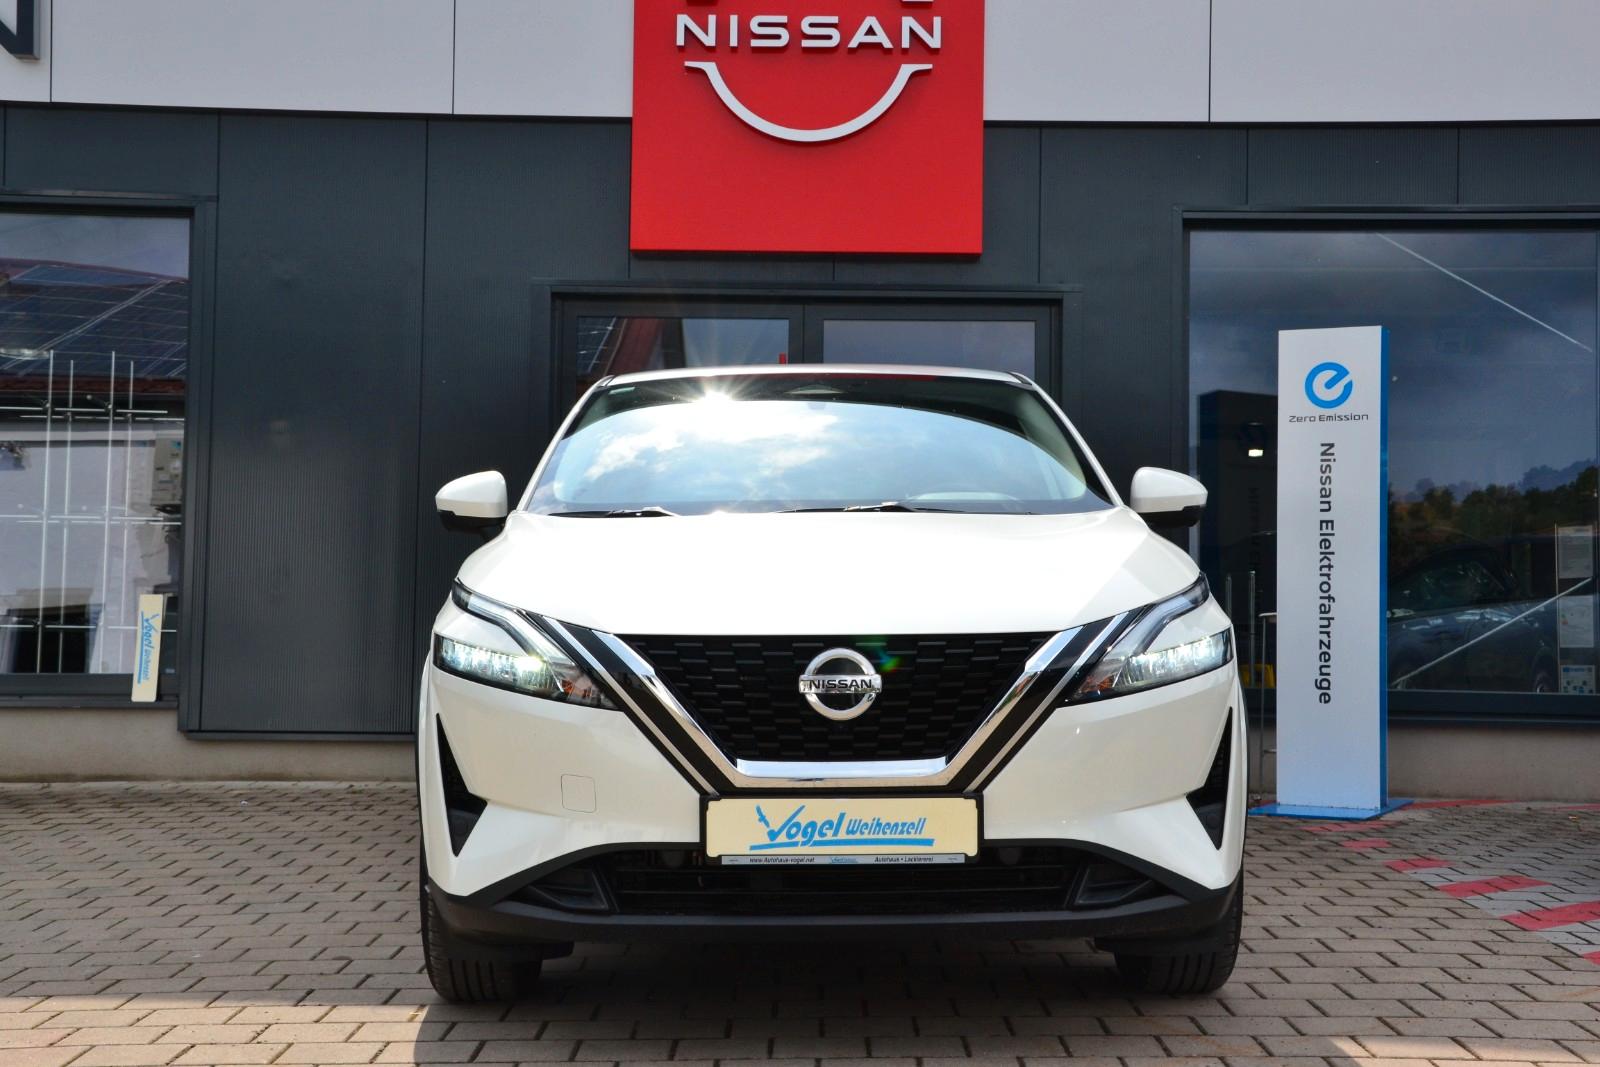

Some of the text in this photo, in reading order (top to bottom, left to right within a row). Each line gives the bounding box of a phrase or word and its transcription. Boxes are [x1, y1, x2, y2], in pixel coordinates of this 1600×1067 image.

[676, 14, 942, 49] NISSAN
[1288, 412, 1369, 423] Zero Emission
[1314, 442, 1336, 704] Nissan Elektrofahrzeuge
[809, 679, 872, 689] NISSAN
[756, 805, 927, 847] Vogel Weihenzell
